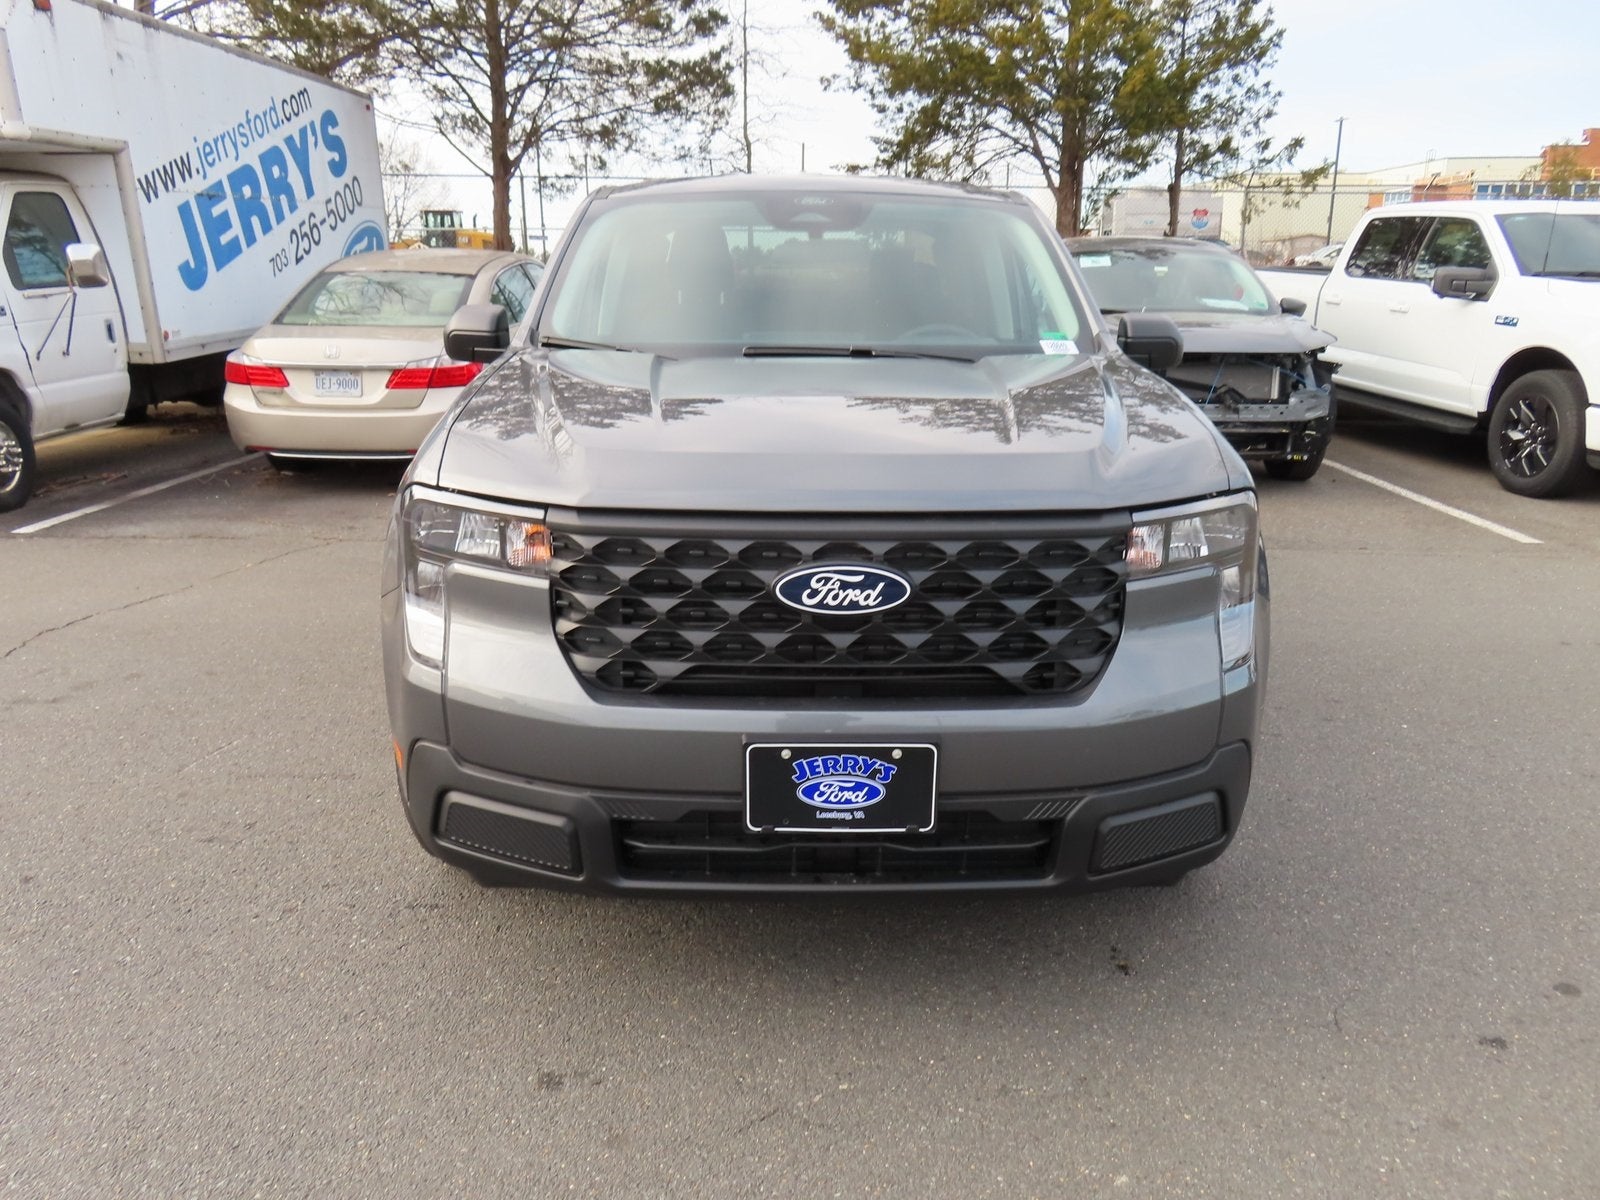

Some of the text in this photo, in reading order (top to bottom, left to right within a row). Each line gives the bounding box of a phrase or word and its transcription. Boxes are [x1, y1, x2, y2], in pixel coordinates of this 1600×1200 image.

[137, 87, 313, 204] www.jerrysford.com
[177, 109, 348, 292] JERRY'S
[290, 175, 363, 266] 256-5000
[802, 573, 886, 606] Ford
[792, 754, 898, 783] JERRY'S
[814, 781, 867, 802] Ford
